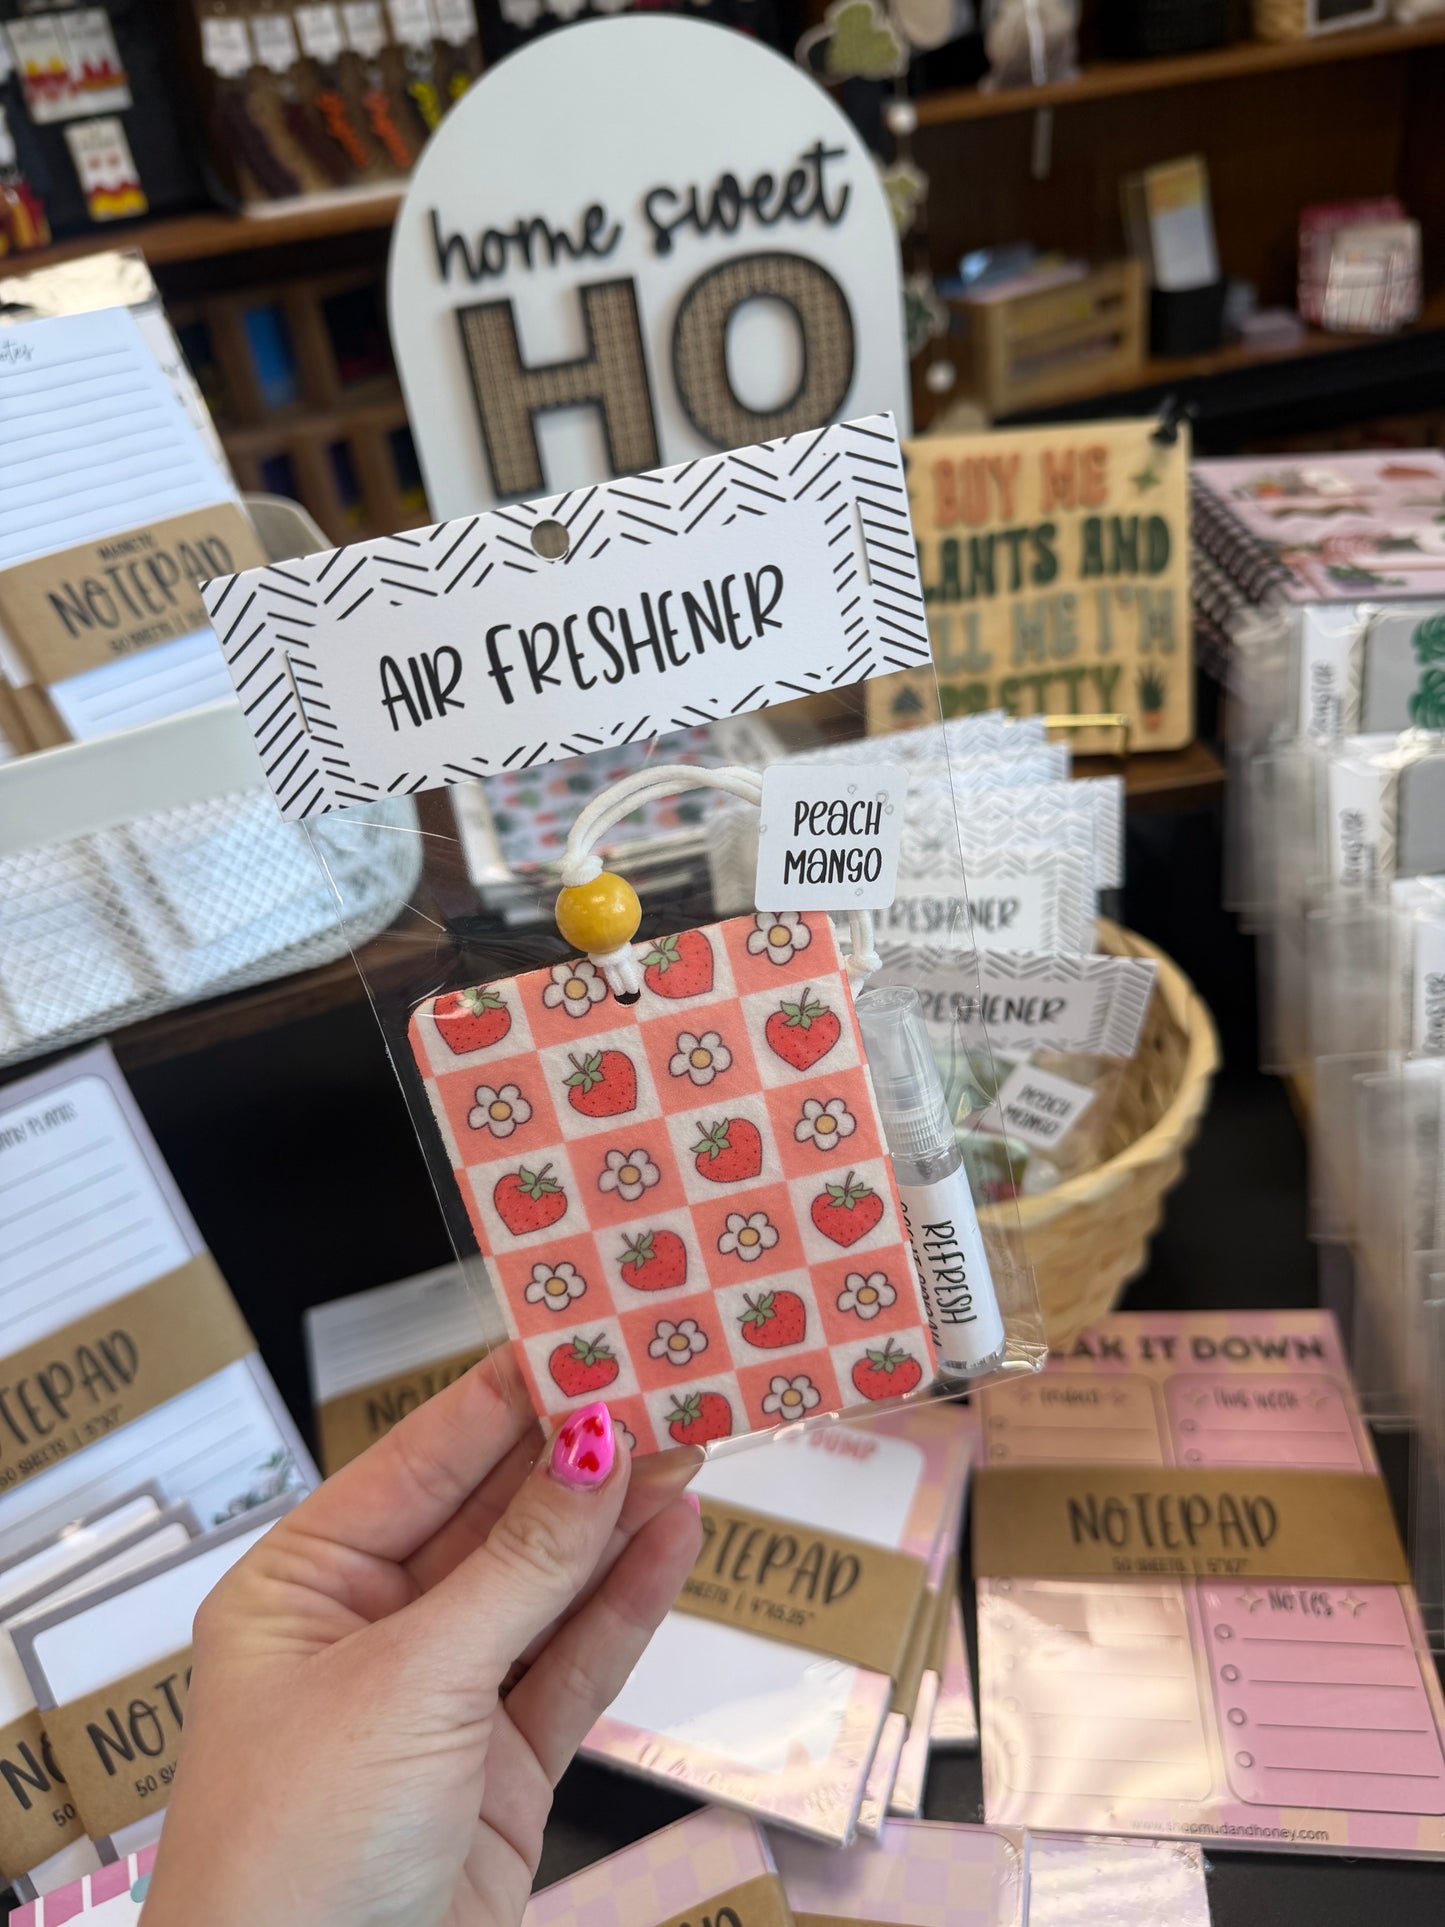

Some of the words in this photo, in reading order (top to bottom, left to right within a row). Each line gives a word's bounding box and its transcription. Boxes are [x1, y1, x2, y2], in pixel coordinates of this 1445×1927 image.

[429, 205, 622, 281] home
[646, 140, 850, 254] sweet
[931, 455, 1024, 531] BUY
[1040, 445, 1108, 514] ME
[47, 533, 236, 640] NOTEPAD
[1081, 513, 1172, 579] AND
[378, 645, 466, 732] AIR
[485, 564, 784, 704] FRESHENER
[921, 1220, 978, 1324] REFRESH
[1140, 1336, 1178, 1361] IT
[1190, 1335, 1326, 1361] DOWN
[1069, 1491, 1279, 1549] NOTEPAD
[134, 1775, 157, 1797] 50
